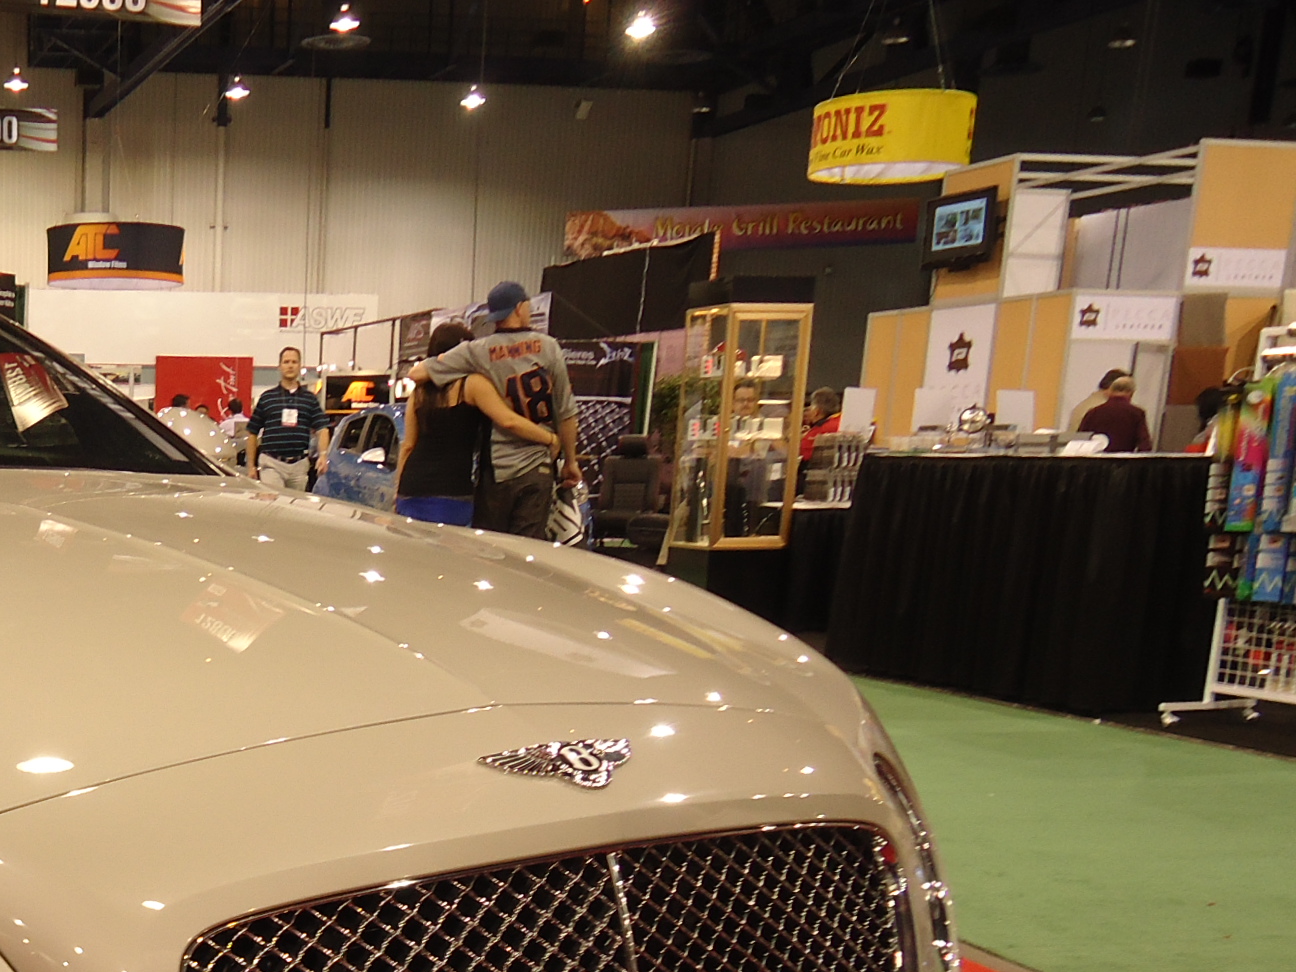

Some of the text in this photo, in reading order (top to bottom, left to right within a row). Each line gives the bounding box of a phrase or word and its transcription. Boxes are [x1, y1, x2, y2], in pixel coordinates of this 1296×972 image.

[832, 146, 853, 159] Car
[855, 143, 884, 157] Wax
[732, 213, 779, 236] Grill
[787, 211, 904, 235] Restaurant
[291, 305, 366, 330] ASWF
[489, 339, 543, 363] MANNING
[505, 365, 554, 425] 18
